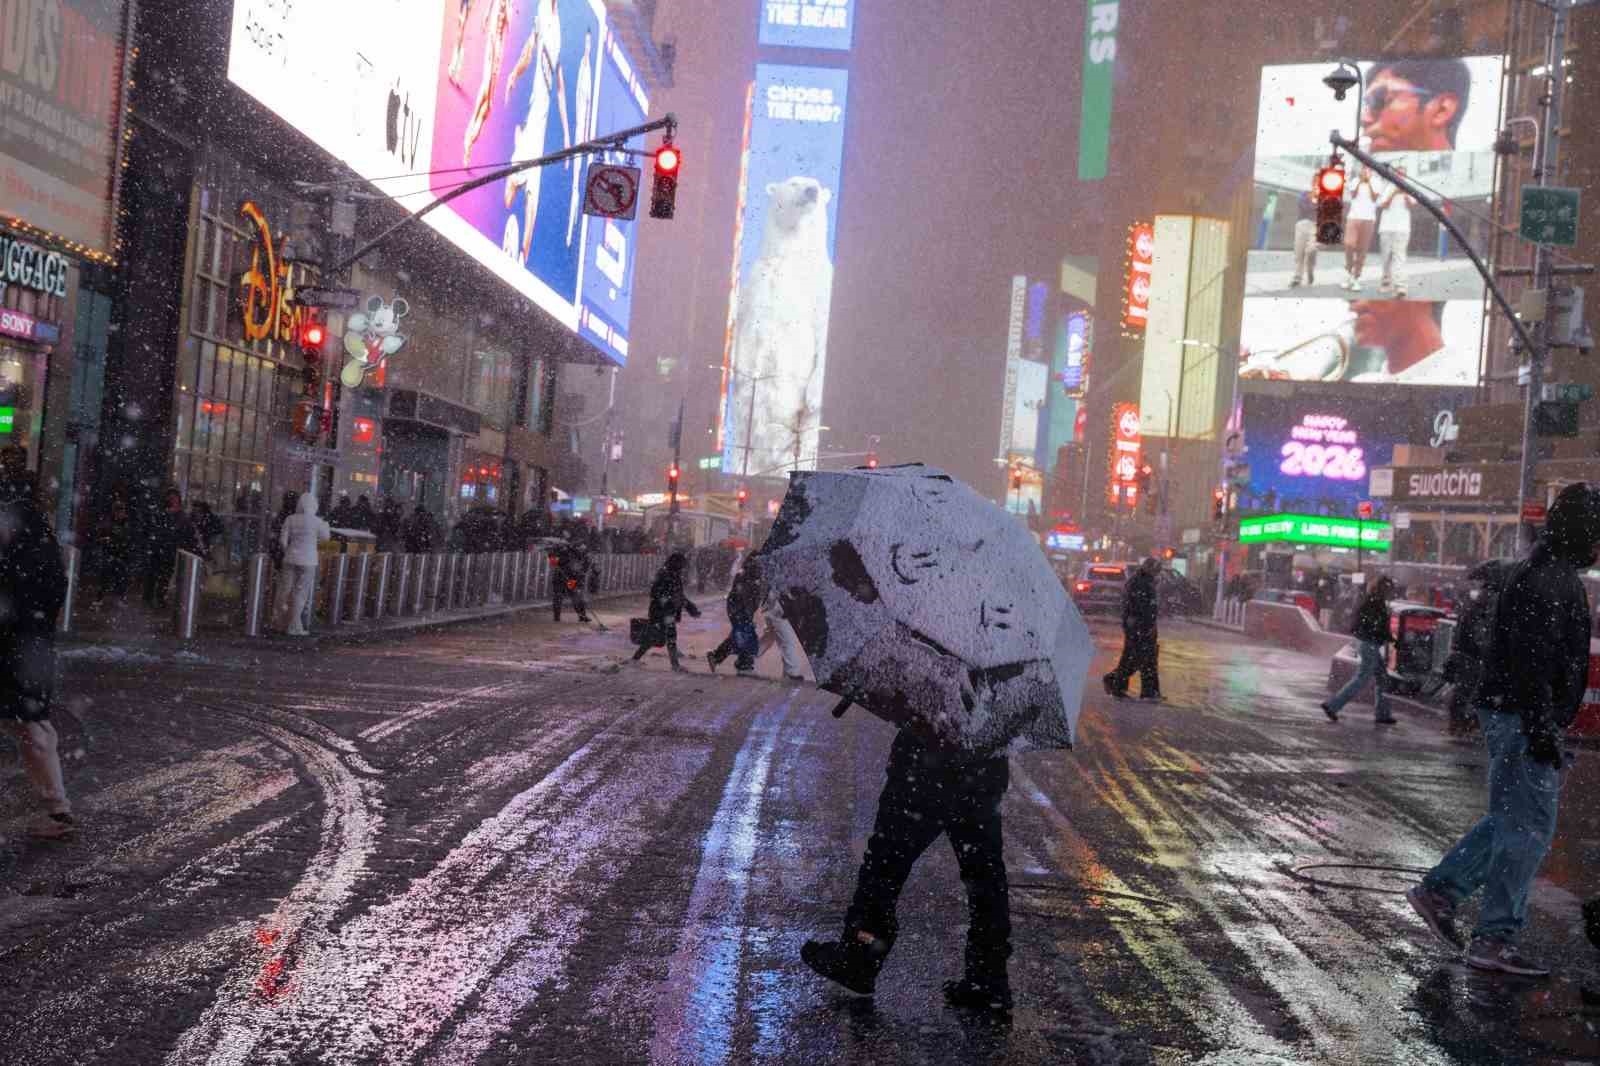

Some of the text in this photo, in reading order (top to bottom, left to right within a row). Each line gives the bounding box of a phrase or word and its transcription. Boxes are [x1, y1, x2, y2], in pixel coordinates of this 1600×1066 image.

[1, 313, 33, 336] SONY
[1280, 441, 1366, 480] 2026
[1408, 468, 1470, 496] swatch
